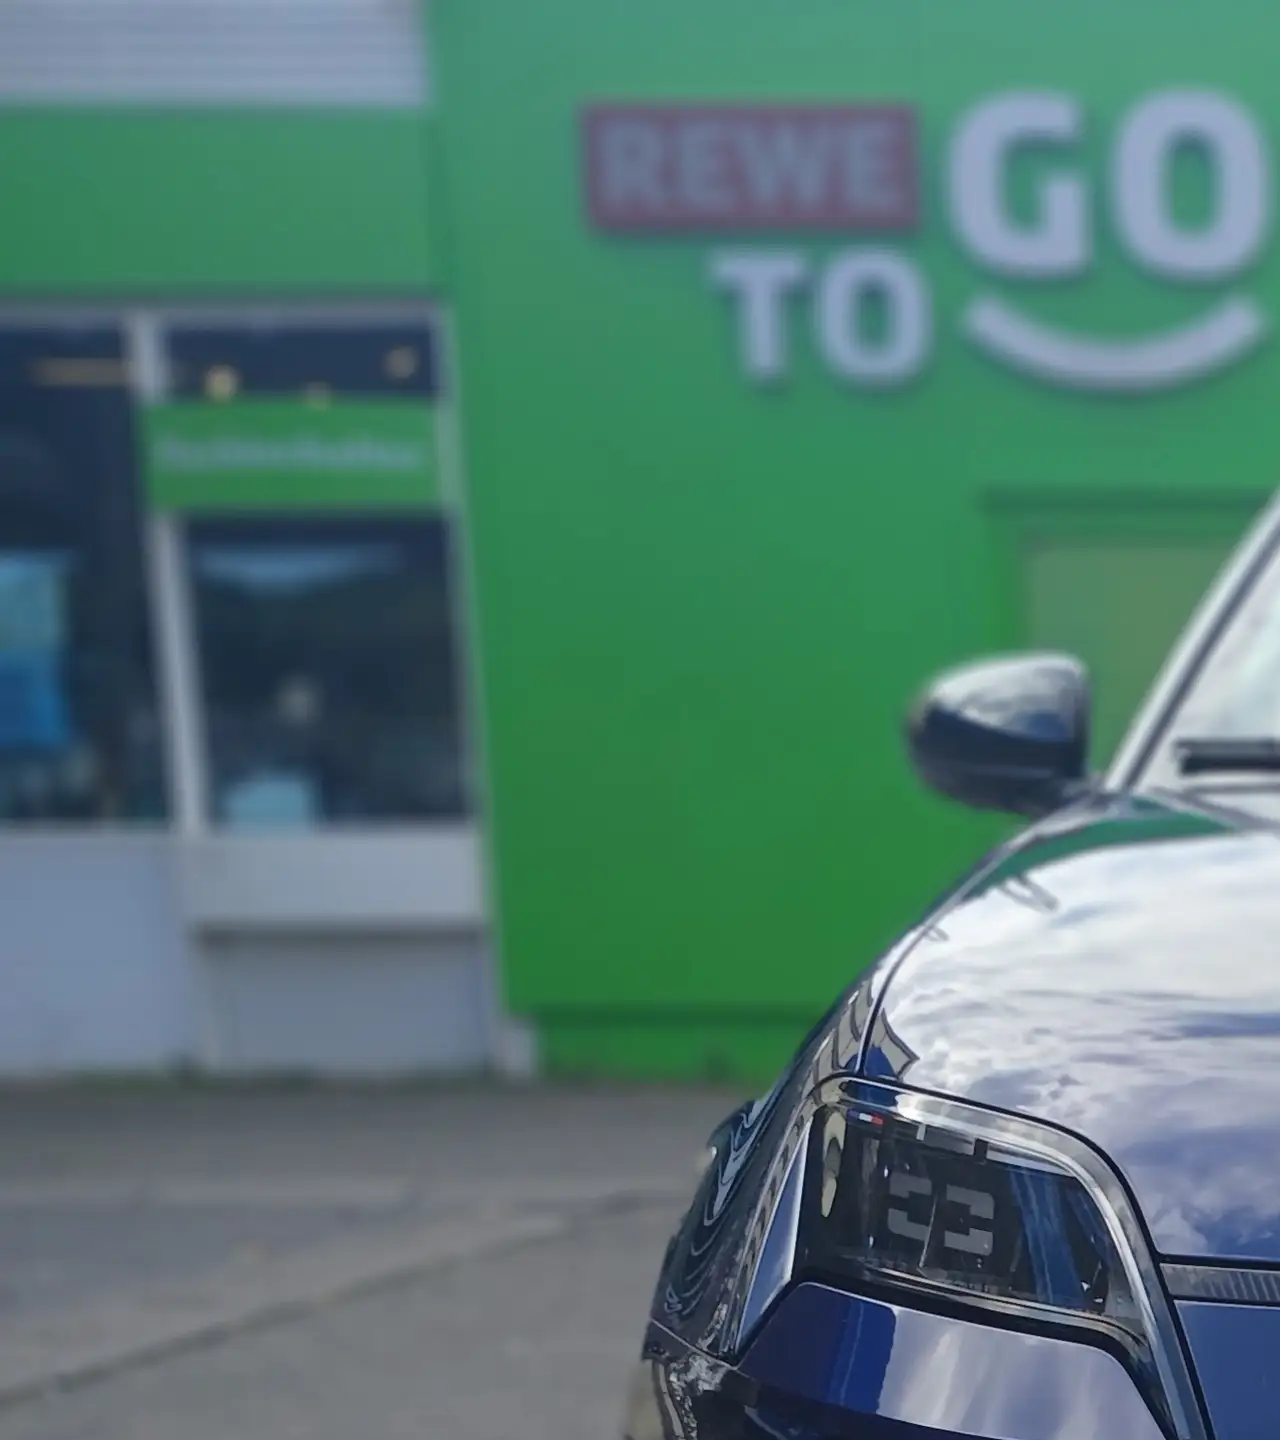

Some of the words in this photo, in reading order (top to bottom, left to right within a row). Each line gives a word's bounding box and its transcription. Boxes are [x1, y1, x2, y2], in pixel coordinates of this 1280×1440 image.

[595, 118, 894, 211] REWE
[950, 90, 1270, 276] GO
[712, 250, 930, 386] TO
